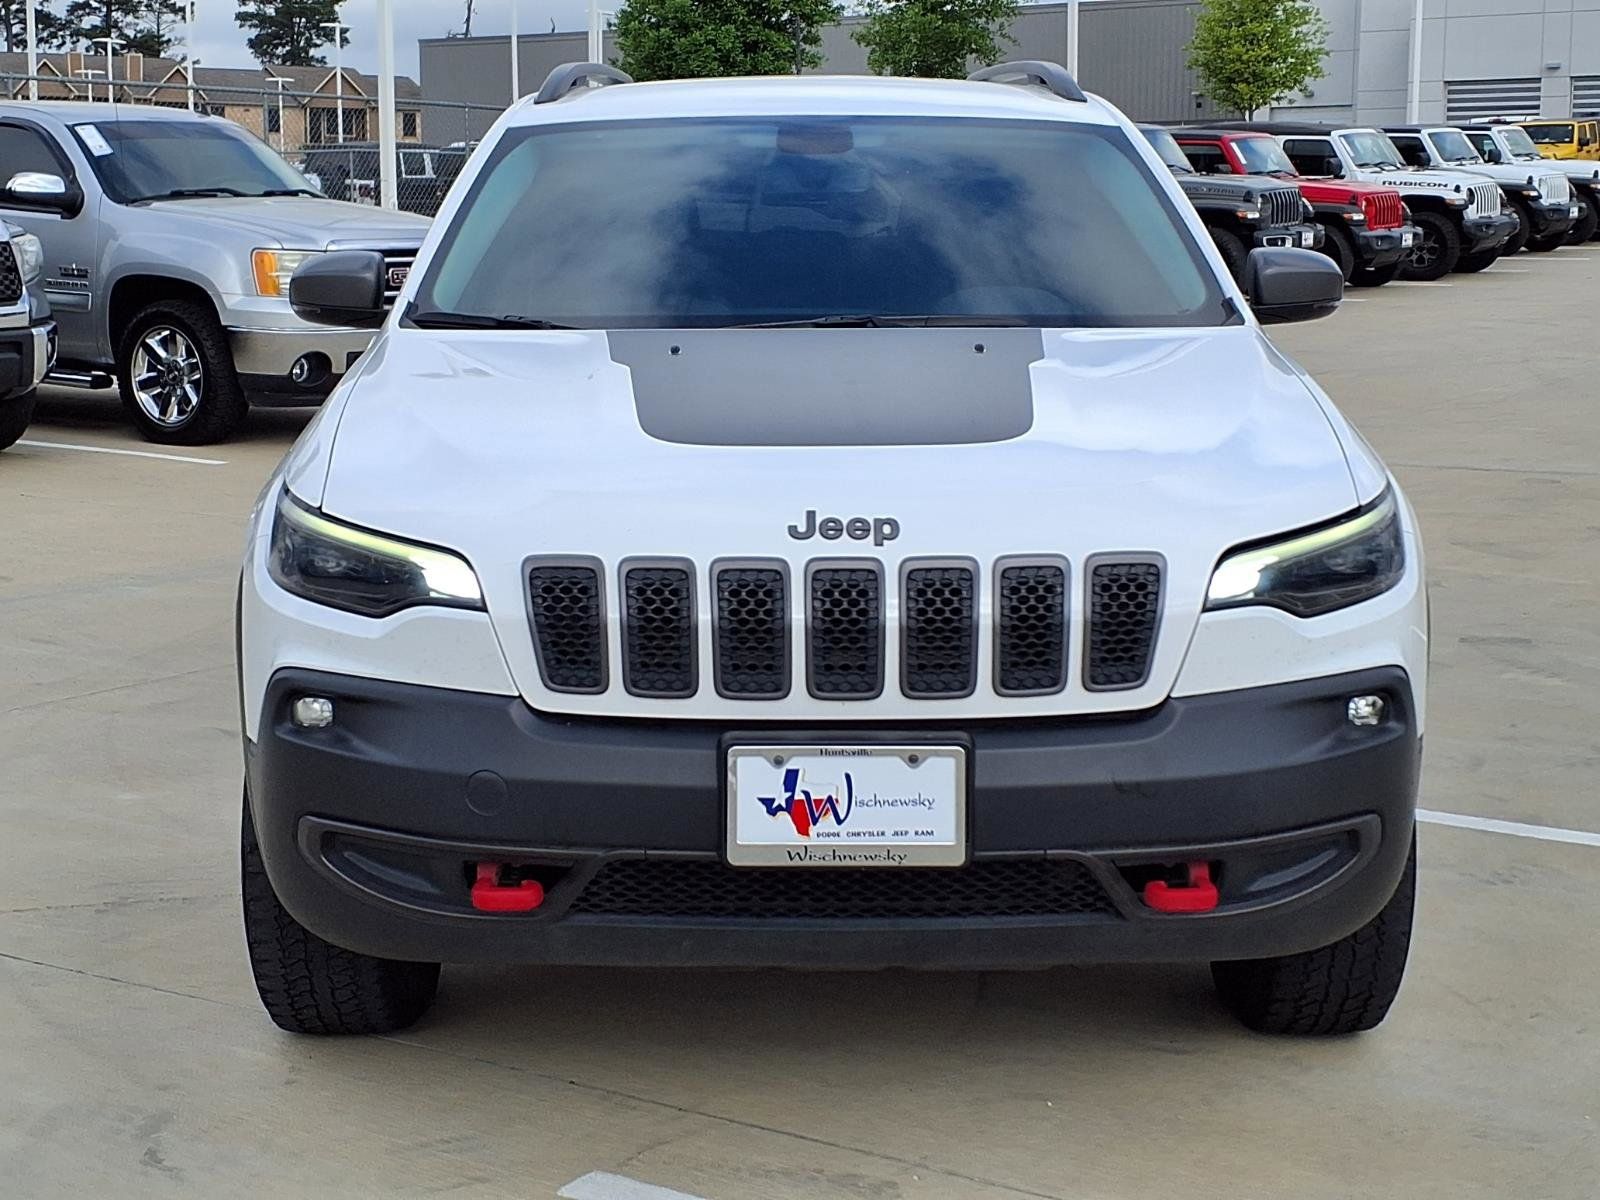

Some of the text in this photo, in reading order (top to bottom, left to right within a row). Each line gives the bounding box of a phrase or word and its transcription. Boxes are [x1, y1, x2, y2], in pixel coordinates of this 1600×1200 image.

[1382, 180, 1449, 188] RUBICON
[787, 509, 901, 547] Jeep
[846, 830, 886, 838] CHRYSLER
[914, 829, 935, 837] RAM
[786, 845, 908, 864] Wischnewsky
